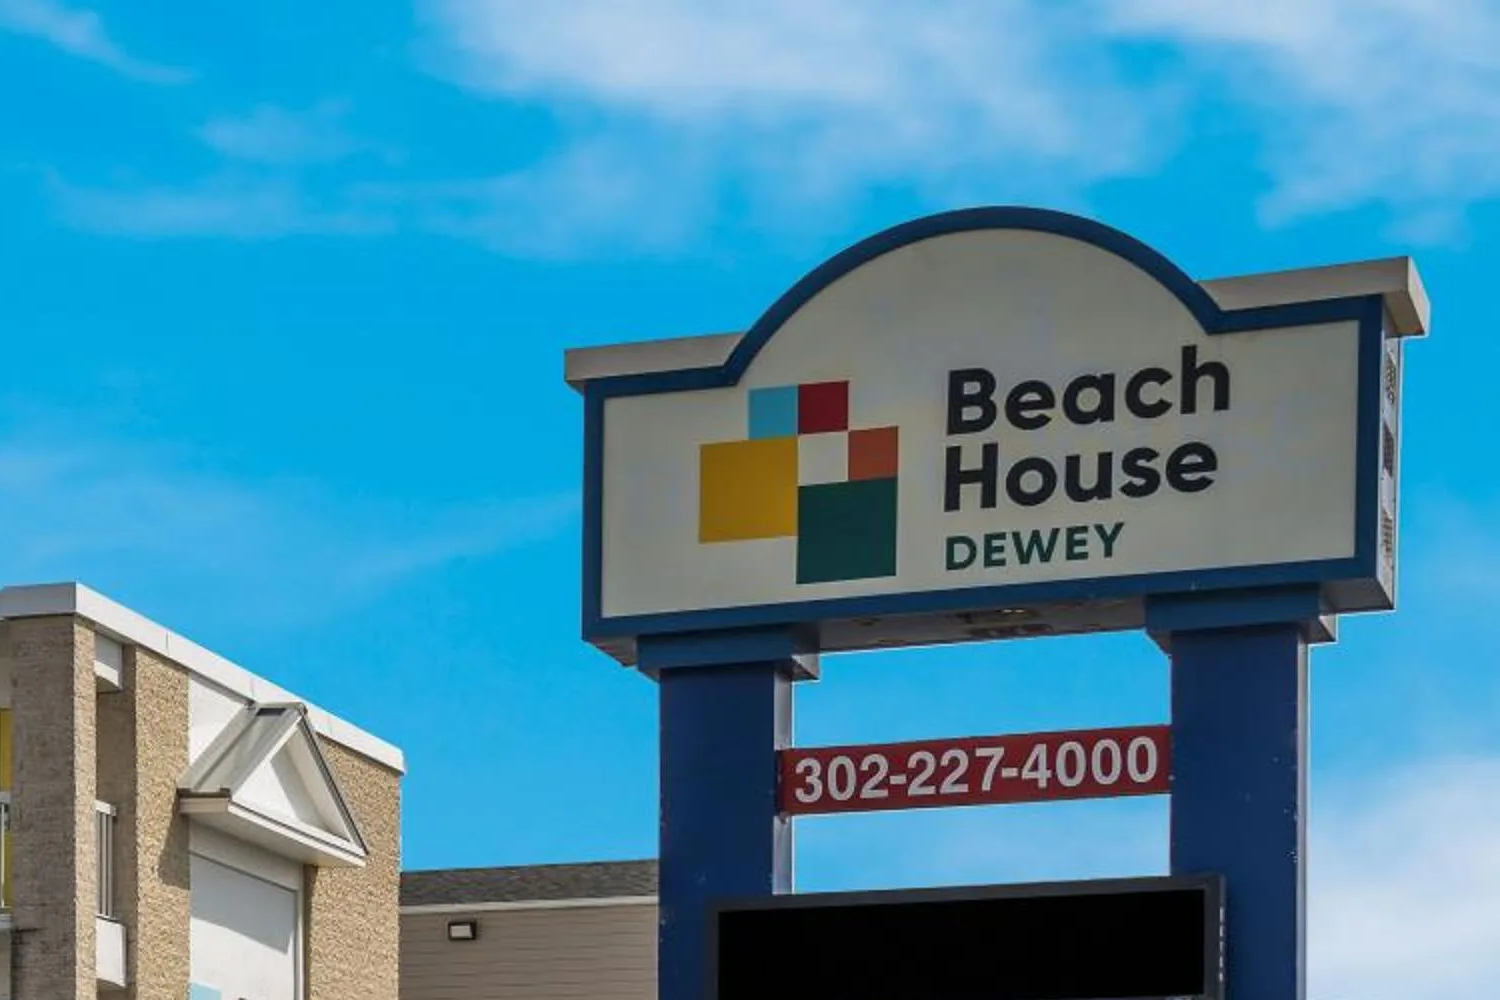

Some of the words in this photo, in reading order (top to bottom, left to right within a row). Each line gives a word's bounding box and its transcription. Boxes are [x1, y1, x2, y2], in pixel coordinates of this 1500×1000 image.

[946, 344, 1232, 436] Beach
[943, 437, 1218, 513] House
[945, 521, 1125, 571] DEWEY
[795, 735, 1158, 803] 302-227-4000
